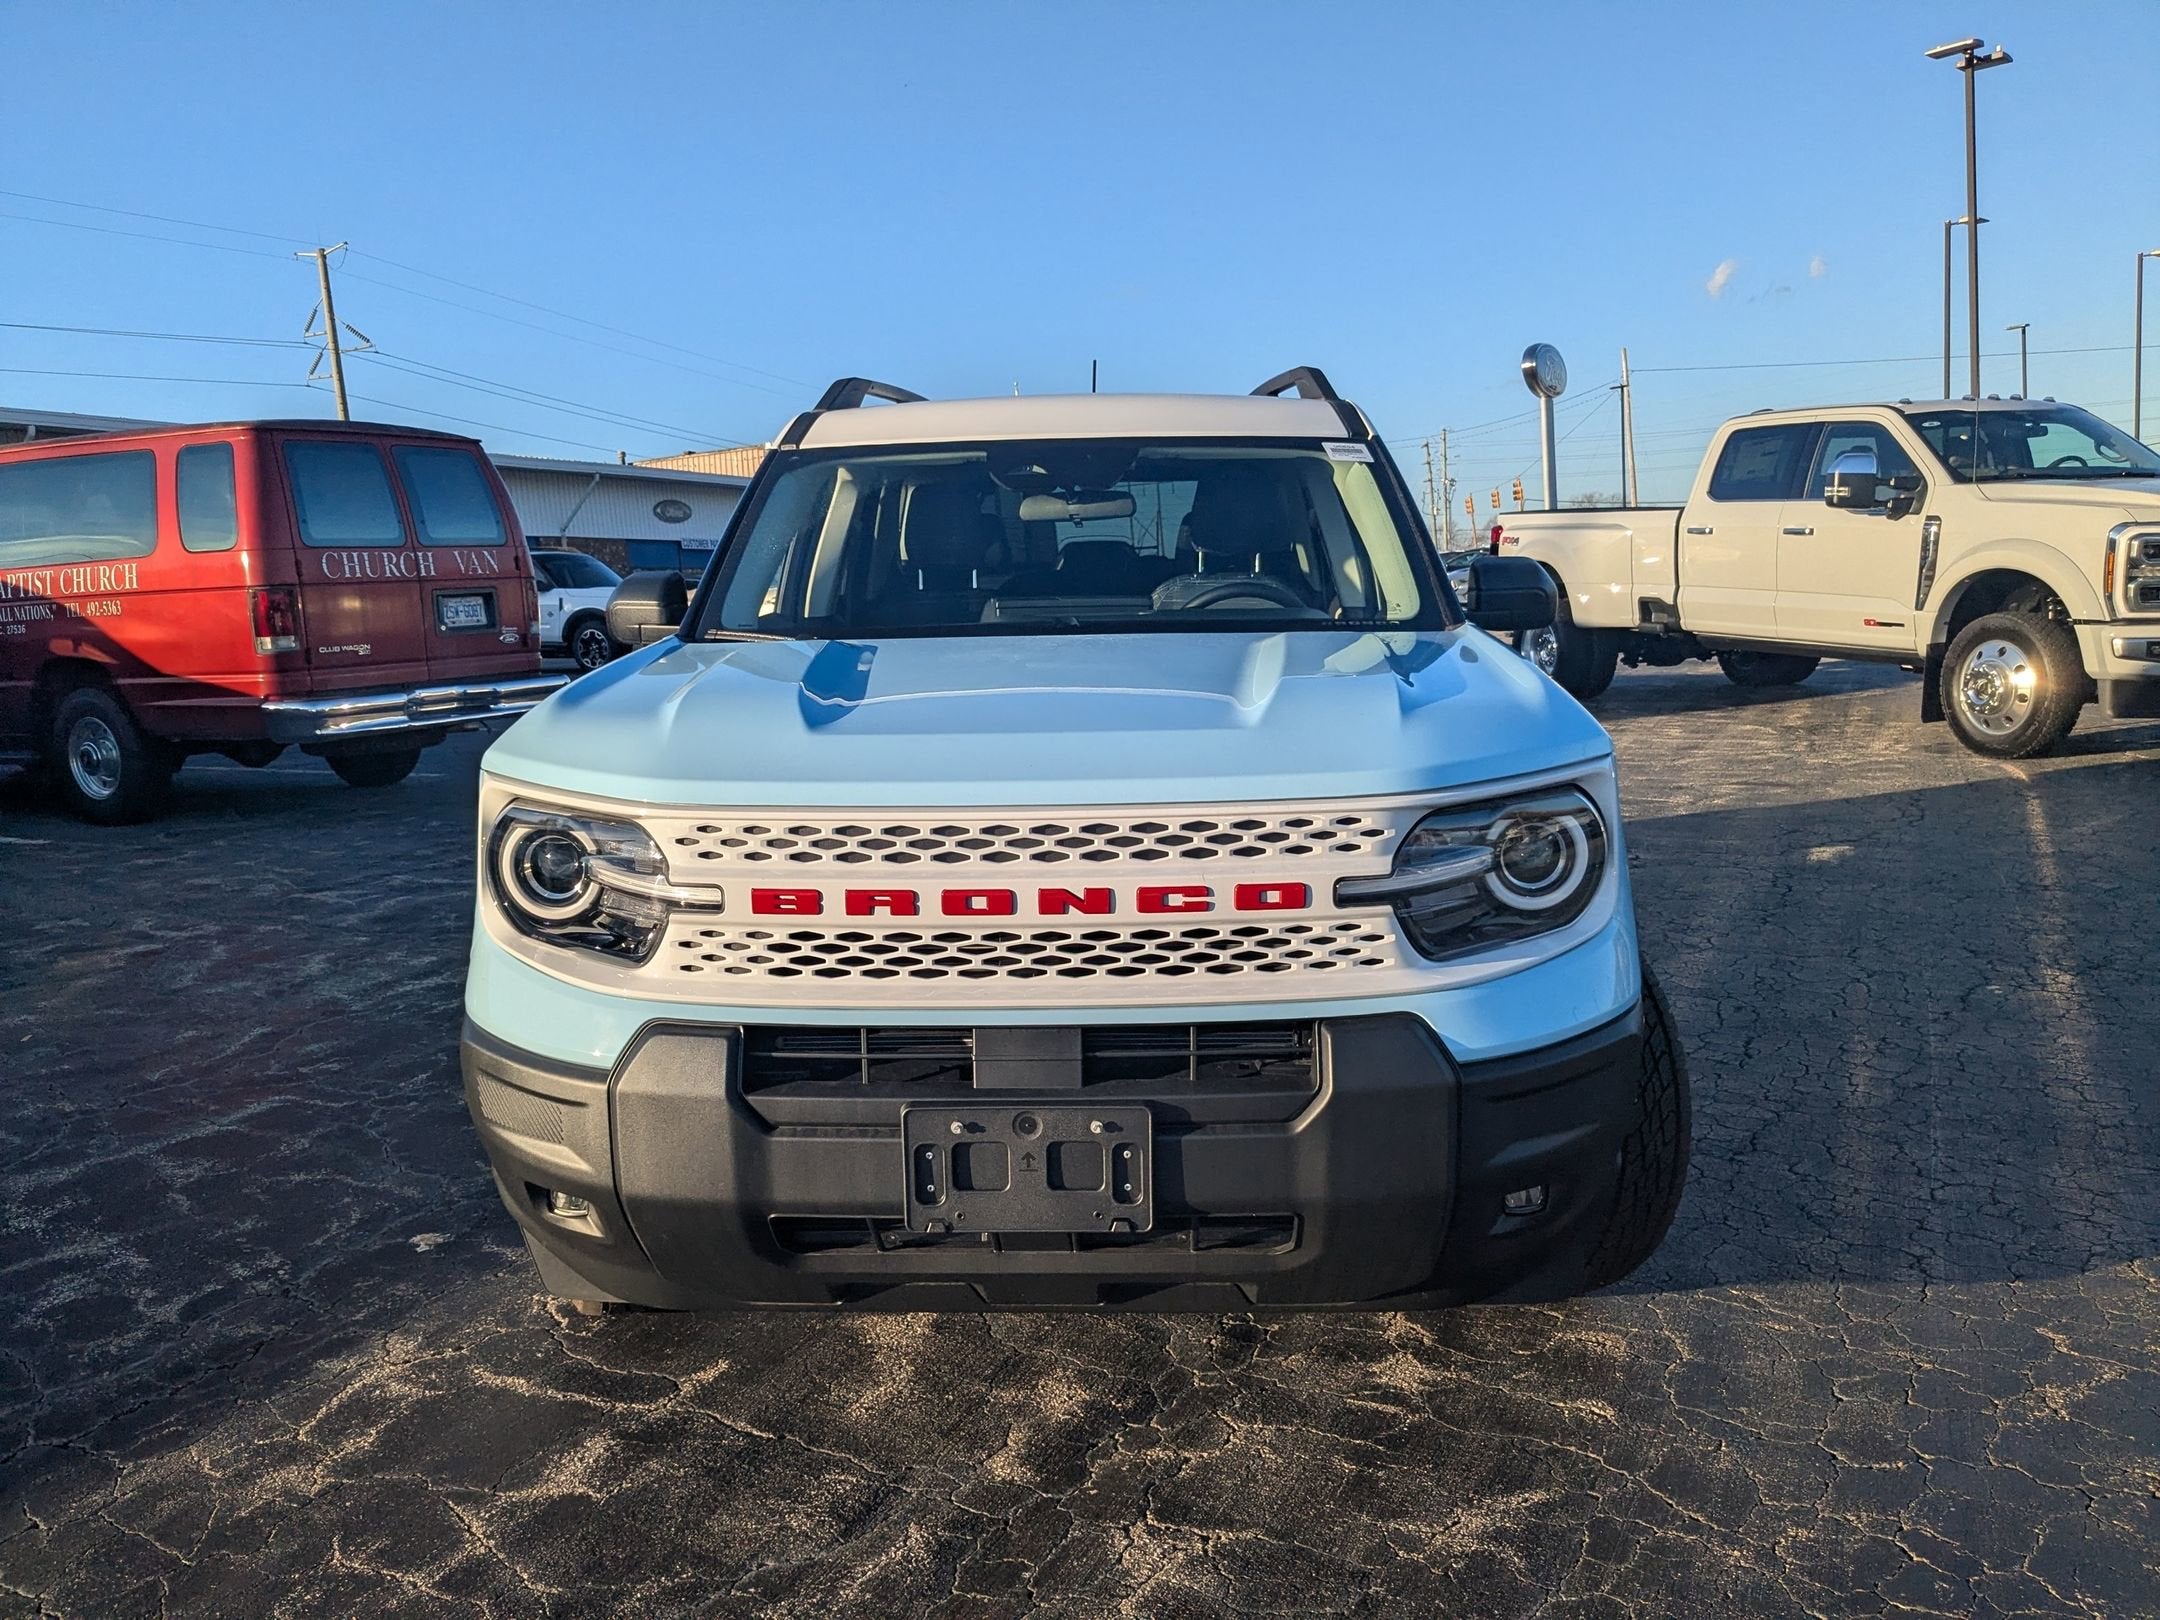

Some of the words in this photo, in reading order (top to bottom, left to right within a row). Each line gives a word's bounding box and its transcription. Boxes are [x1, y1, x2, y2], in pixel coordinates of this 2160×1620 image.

[60, 563, 138, 594] CHURCH
[321, 552, 437, 579] CHURCH
[453, 550, 500, 575] VAN
[65, 602, 85, 618] TEL.
[87, 600, 121, 616] 492-5363
[319, 645, 340, 653] CLUB
[751, 882, 1308, 916] BRONCO
